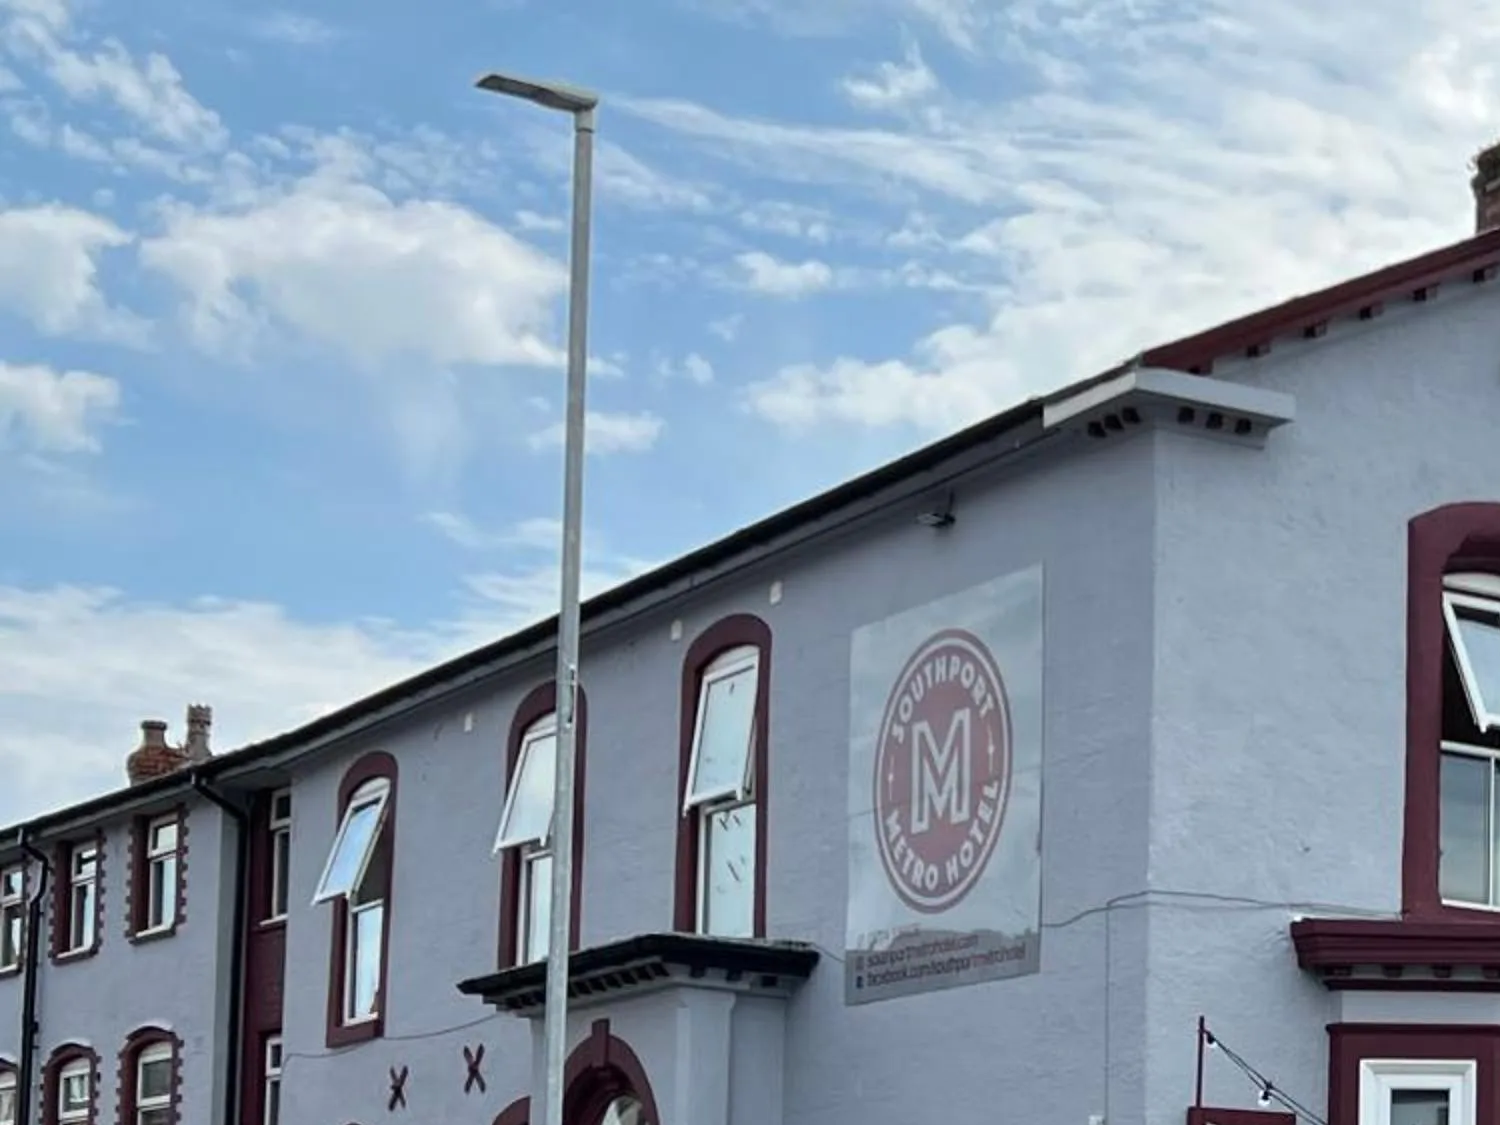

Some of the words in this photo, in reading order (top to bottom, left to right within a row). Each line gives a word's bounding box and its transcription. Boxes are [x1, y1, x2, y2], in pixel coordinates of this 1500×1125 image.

[892, 655, 994, 745] SOUTHPORT
[911, 707, 971, 835] M
[886, 809, 939, 891] METRO
[945, 780, 999, 886] HOTEL
